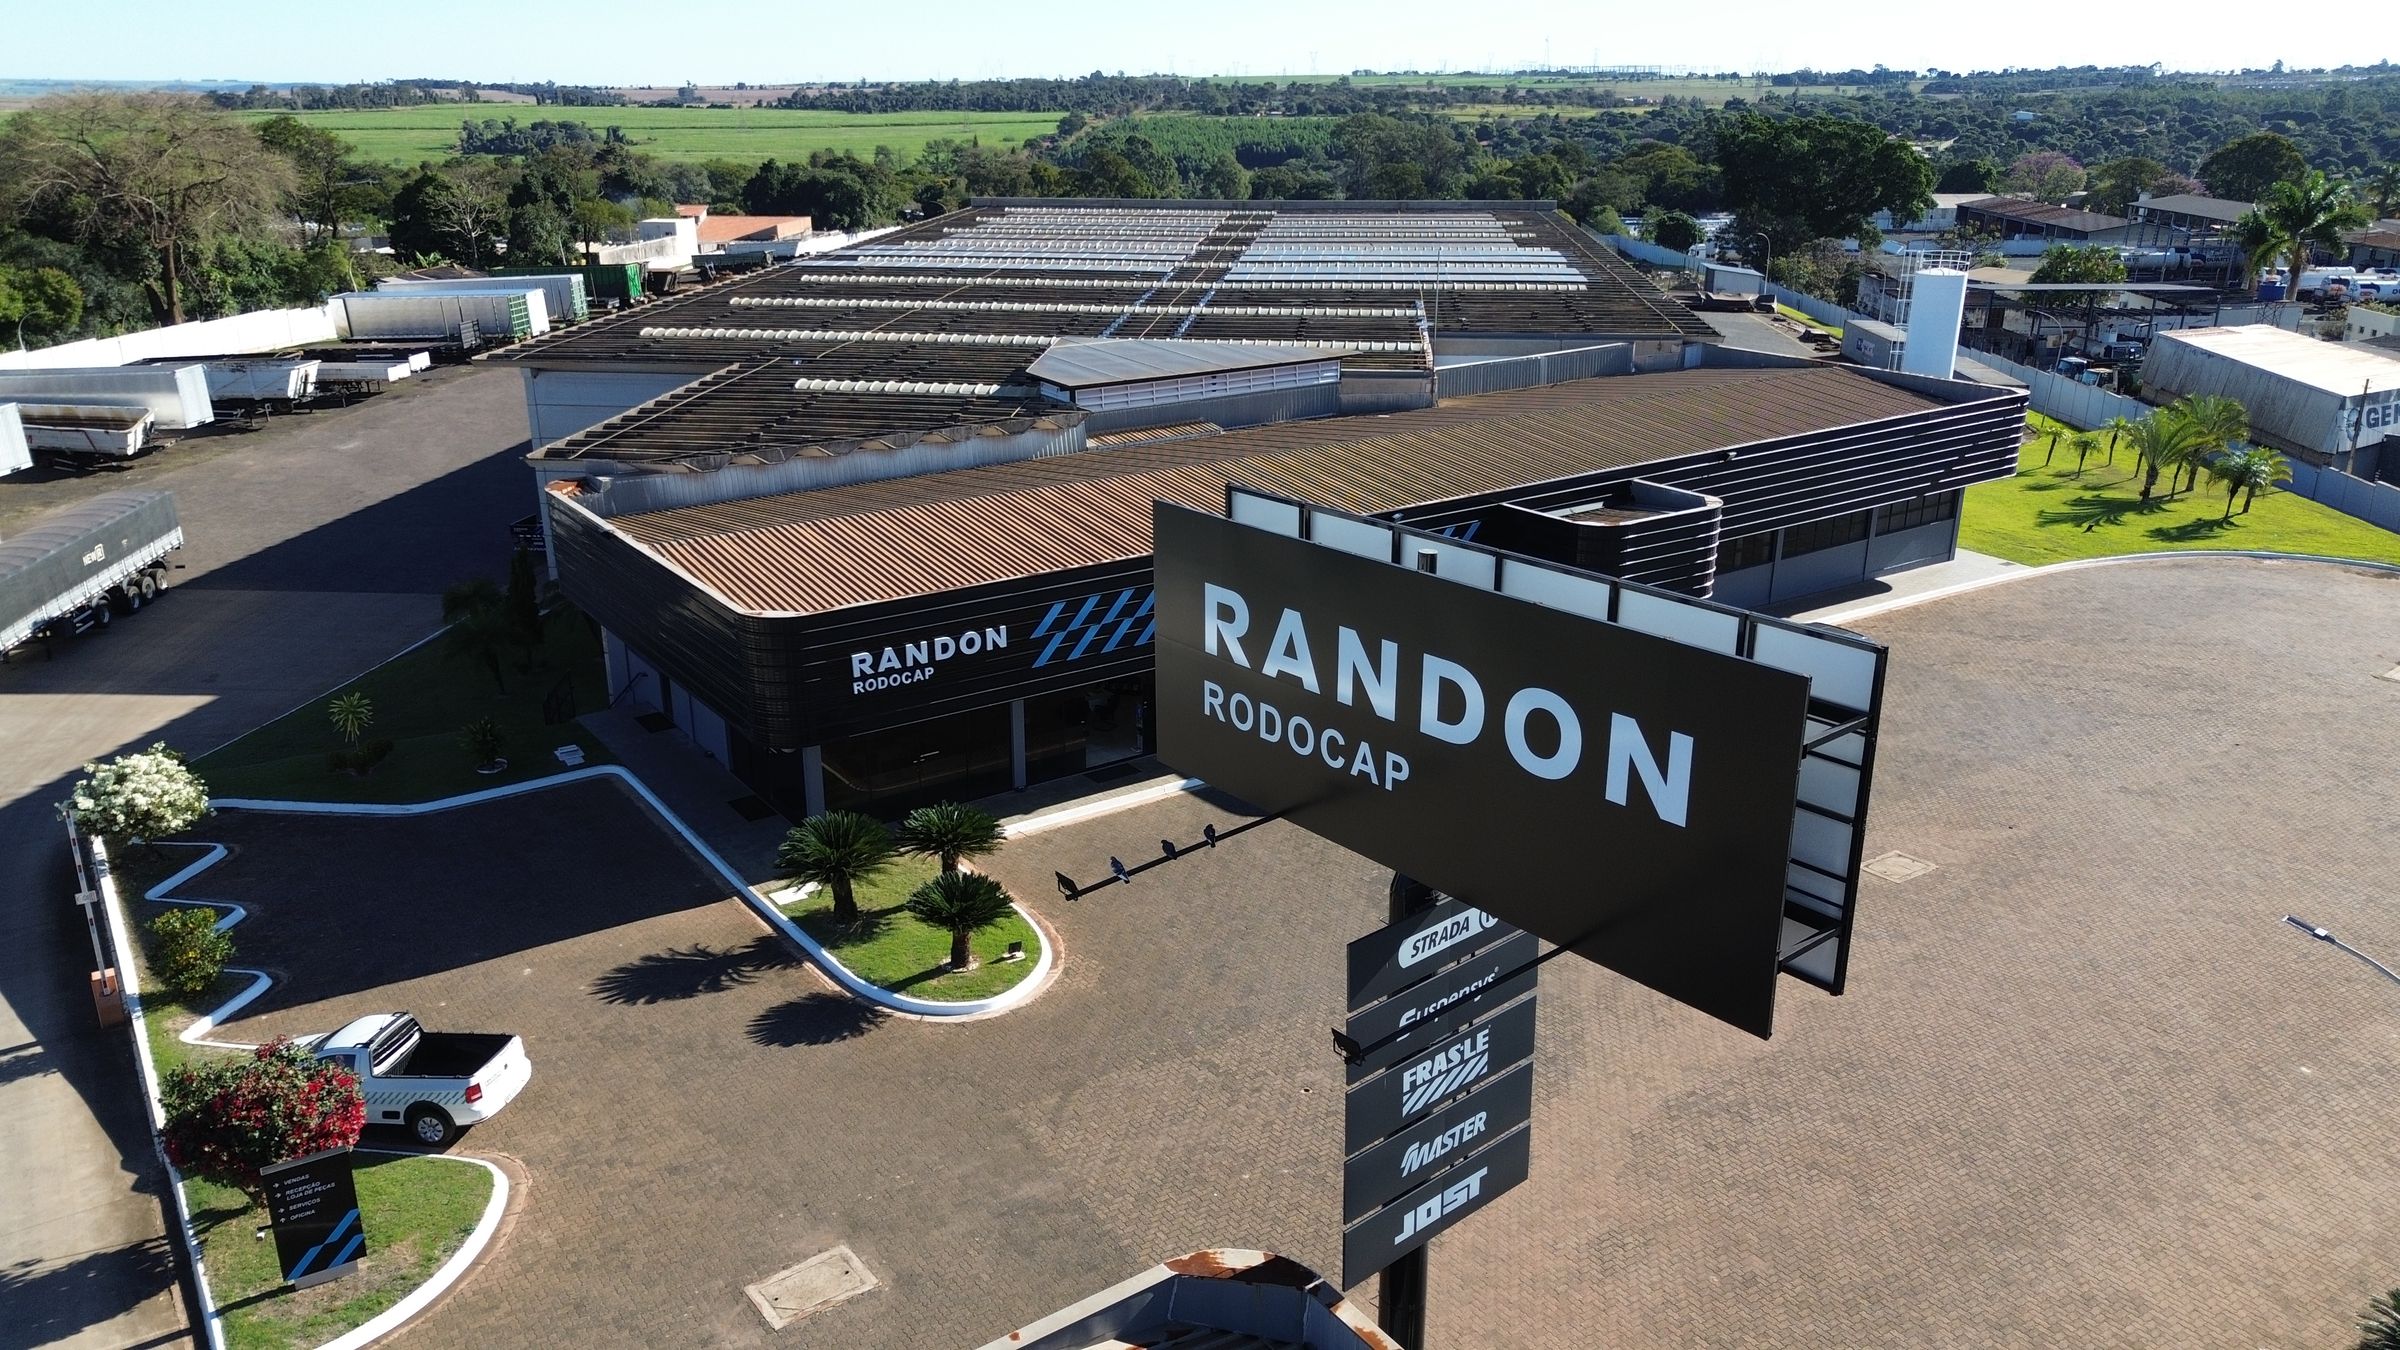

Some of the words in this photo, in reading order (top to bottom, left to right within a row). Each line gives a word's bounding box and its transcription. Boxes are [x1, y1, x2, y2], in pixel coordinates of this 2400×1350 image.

[851, 625, 1008, 678] RANDON
[853, 667, 935, 695] RODOCAP
[1204, 581, 1694, 828] RANDON
[1204, 680, 1410, 791] RODOCAP
[1411, 916, 1470, 959] STRADA
[1400, 1111, 1487, 1178] MASTER
[284, 1174, 310, 1185] VENDAS
[1394, 1166, 1488, 1245] JOST
[290, 1210, 315, 1220] OFICINA
